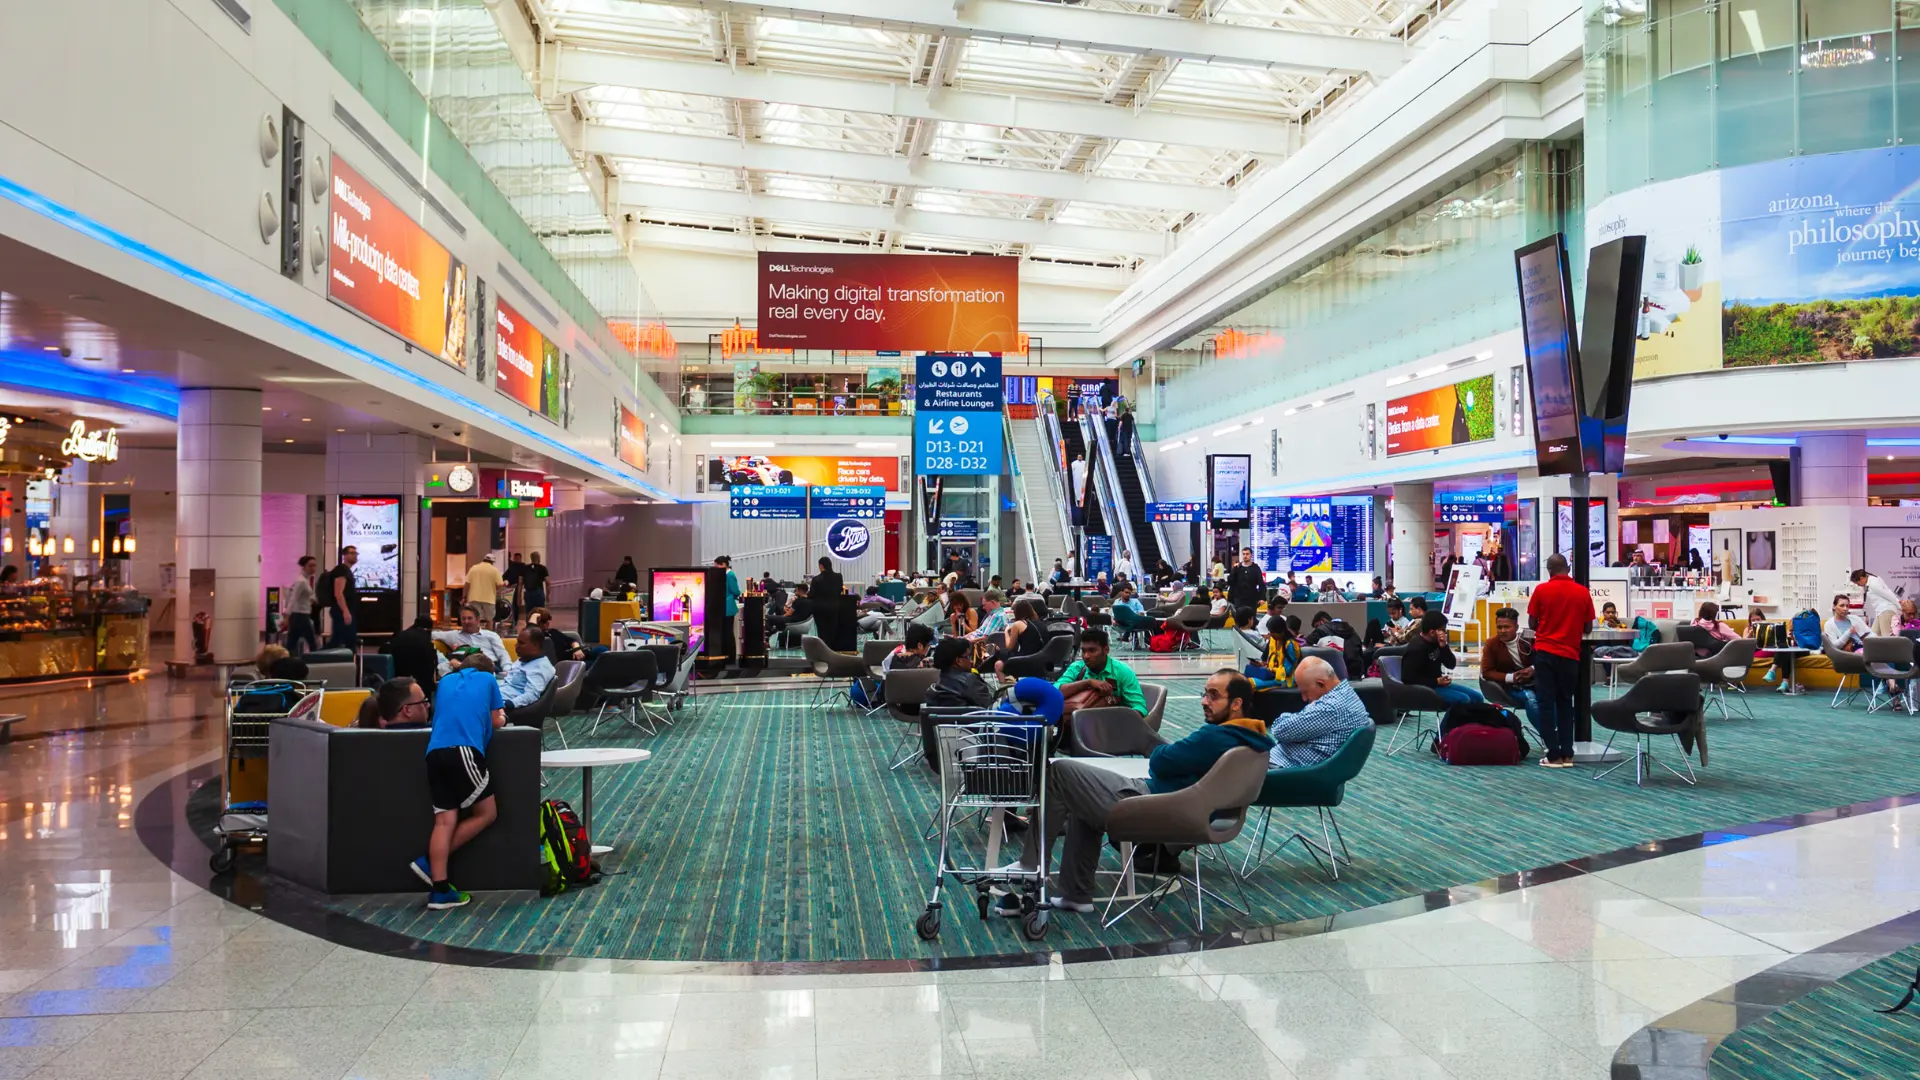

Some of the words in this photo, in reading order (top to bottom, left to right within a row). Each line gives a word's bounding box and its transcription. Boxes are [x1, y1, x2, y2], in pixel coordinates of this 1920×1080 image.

[1768, 193, 1840, 213] arizona,
[1836, 205, 1872, 217] where
[1875, 201, 1894, 214] the
[1788, 211, 1920, 255] philosophy
[333, 211, 384, 283] Milk-producing
[384, 251, 398, 285] data
[1837, 248, 1896, 264] journey
[769, 264, 790, 272] DELL
[790, 265, 834, 275] Technologies
[769, 283, 829, 304] Making
[834, 284, 882, 304] digital
[887, 287, 1005, 303] transformation
[769, 303, 798, 319] real
[803, 306, 849, 323] every
[854, 304, 886, 323] day.
[935, 390, 982, 398] Restaurants
[961, 400, 994, 409] Lounges
[838, 467, 855, 475] Race
[838, 475, 858, 483] driven
[859, 475, 868, 484] by
[835, 526, 868, 552] Boots
[1588, 588, 1611, 597] ace
